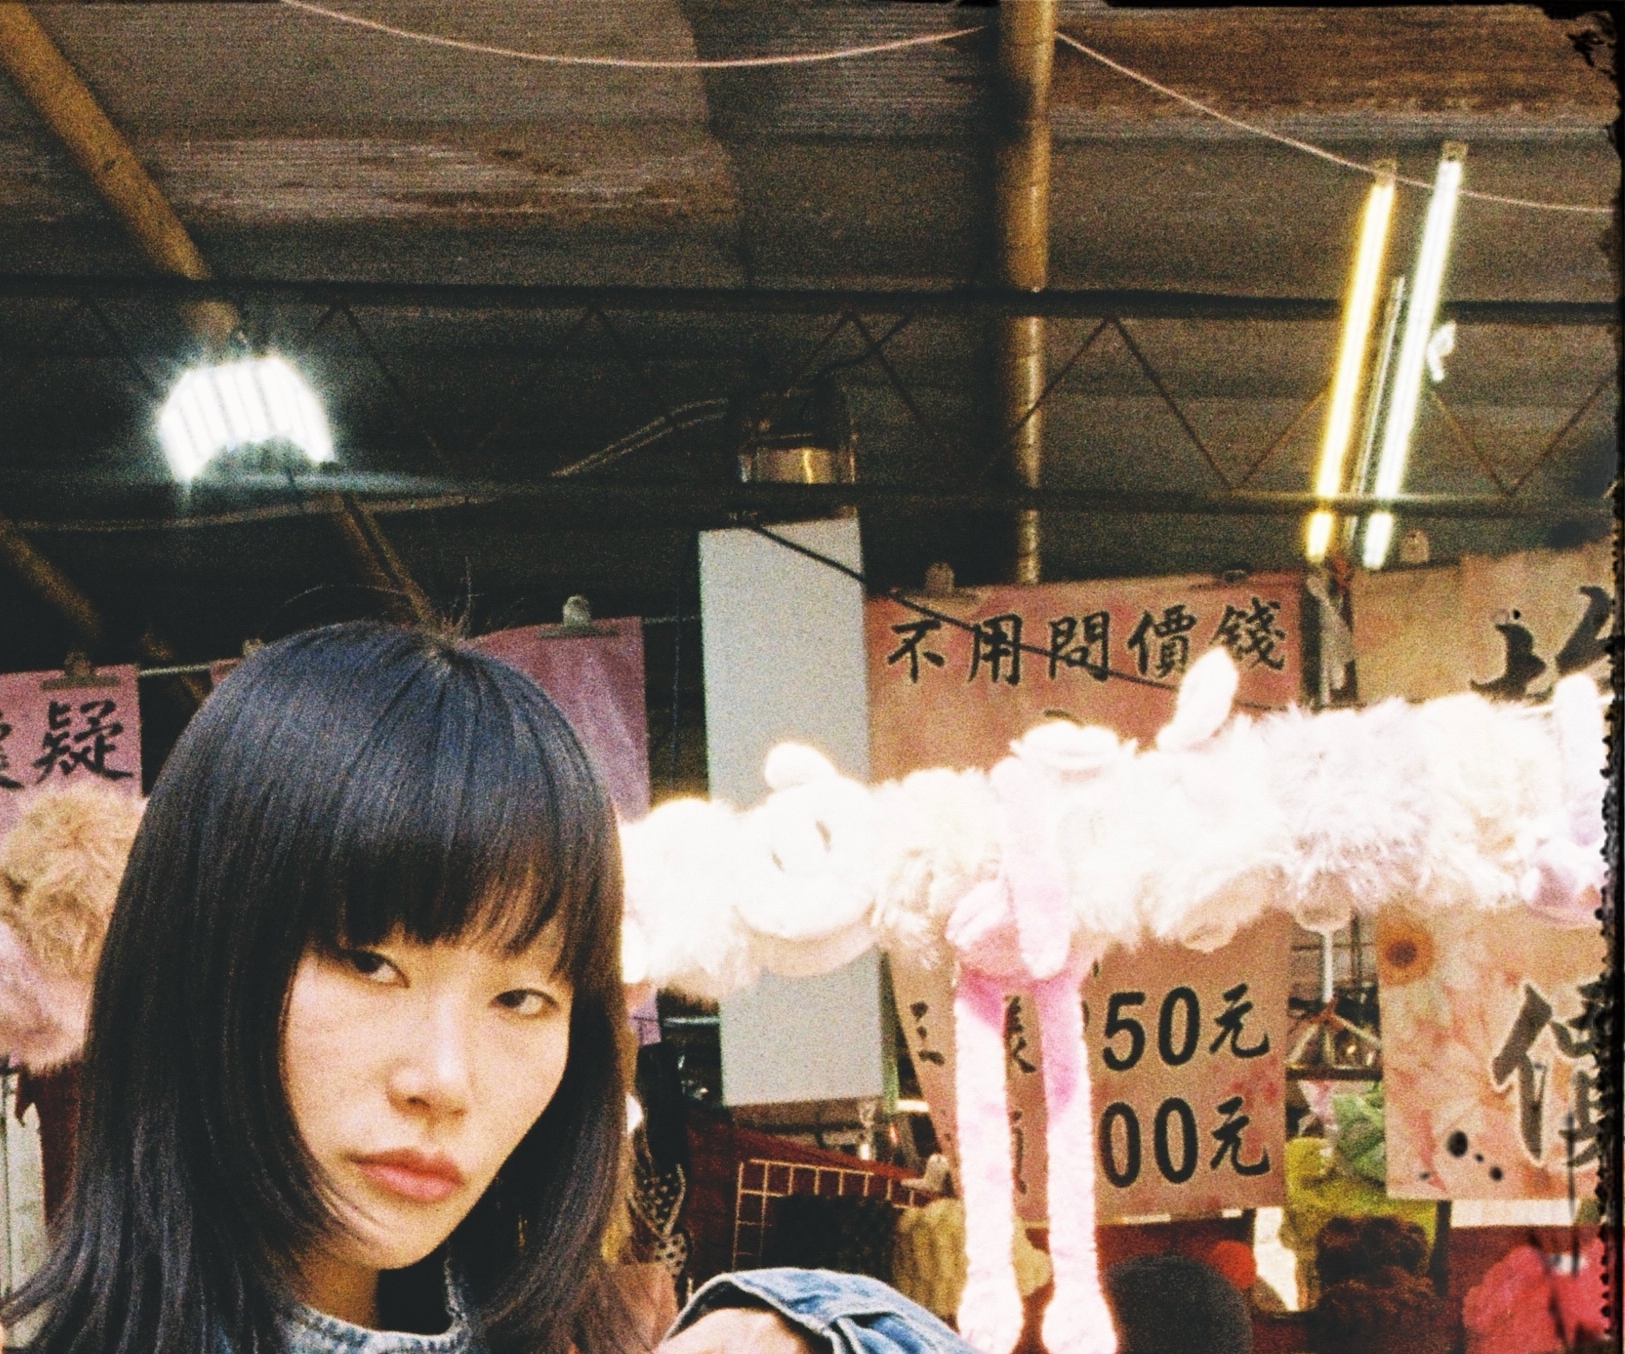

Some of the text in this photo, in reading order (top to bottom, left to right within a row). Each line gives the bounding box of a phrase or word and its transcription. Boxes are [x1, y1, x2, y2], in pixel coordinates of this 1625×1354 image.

[887, 597, 1287, 685] 不用問價錢
